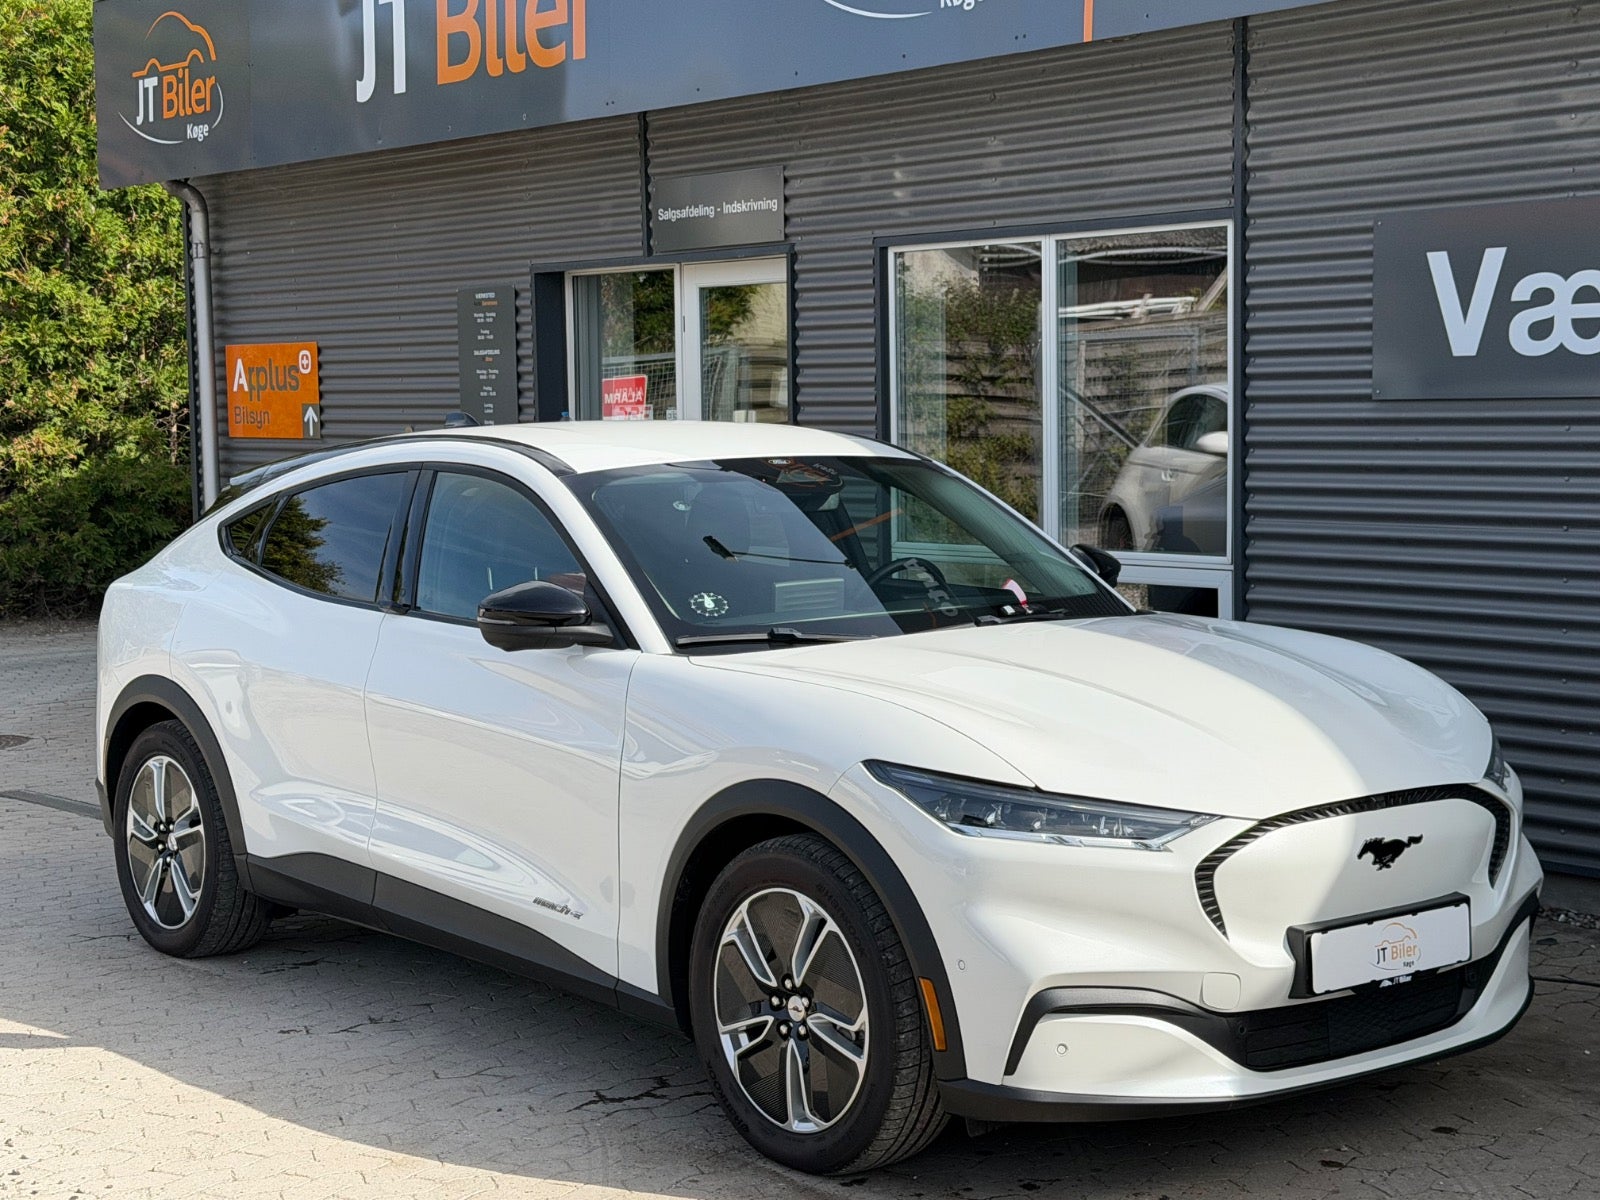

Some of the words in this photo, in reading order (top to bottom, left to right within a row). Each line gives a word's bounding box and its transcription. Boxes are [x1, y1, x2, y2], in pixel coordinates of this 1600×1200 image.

[357, 0, 406, 103] JT
[136, 76, 158, 126] JT
[163, 68, 216, 119] Biler
[187, 123, 209, 142] Køge
[658, 204, 715, 222] Salgsafdeling
[723, 197, 778, 214] Indskrivning
[234, 405, 270, 429] Bilsyn
[1376, 947, 1388, 965] JT
[1391, 943, 1417, 960] Biler
